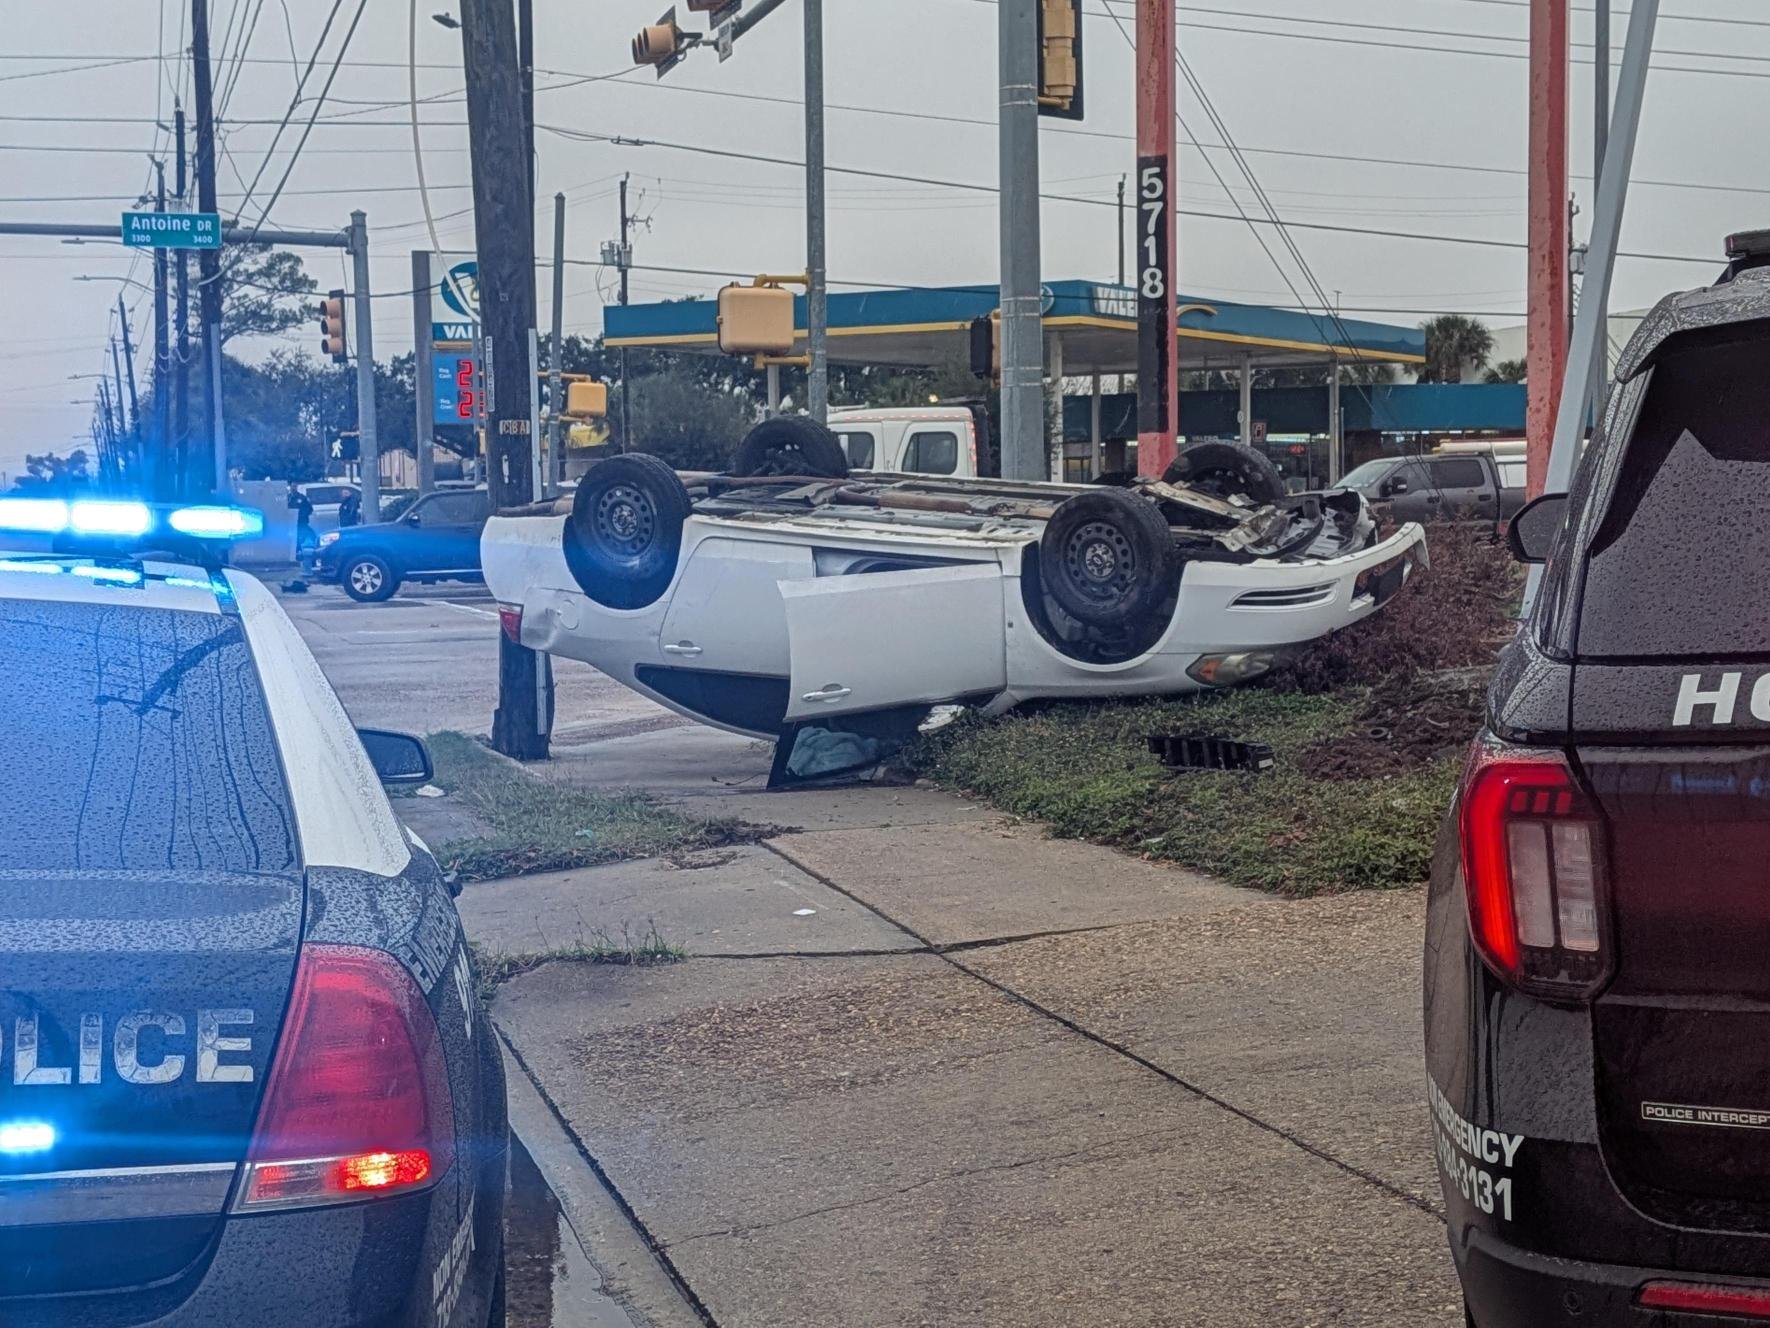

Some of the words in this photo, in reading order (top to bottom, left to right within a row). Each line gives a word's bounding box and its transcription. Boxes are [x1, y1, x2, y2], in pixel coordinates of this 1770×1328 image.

[131, 216, 191, 231] Antoine
[197, 220, 212, 231] DR
[1142, 167, 1164, 298] 5718
[192, 235, 212, 243] 3400
[1095, 287, 1138, 317] VALE
[442, 325, 481, 339] VAL
[1672, 672, 1770, 726] H
[0, 1009, 254, 1085] LICE
[1646, 1106, 1694, 1119] POLICE
[1437, 1089, 1525, 1168] EMERGENCY
